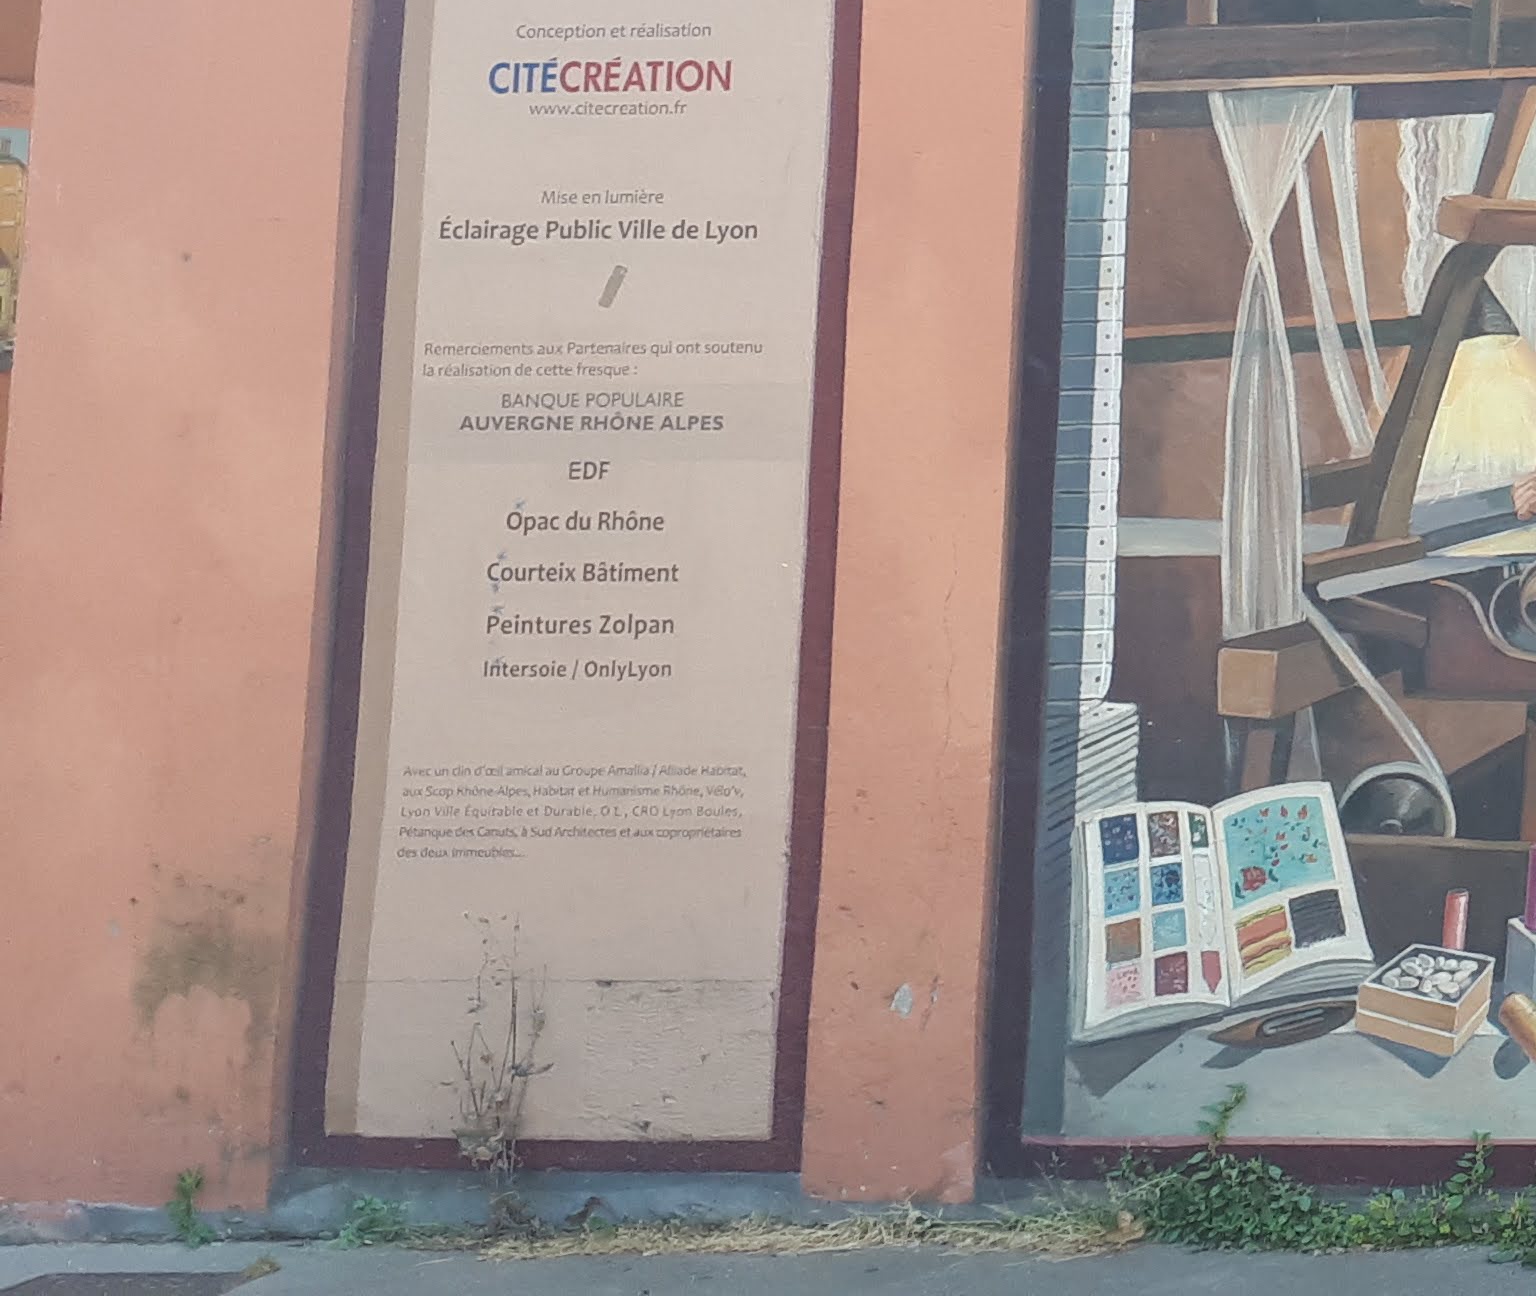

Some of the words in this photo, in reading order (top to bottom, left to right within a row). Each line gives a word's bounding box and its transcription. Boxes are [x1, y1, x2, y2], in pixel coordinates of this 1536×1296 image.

[516, 24, 605, 41] Conception
[610, 25, 625, 38] et
[630, 23, 712, 37] réalisation
[488, 57, 732, 94] CITÉCRÉATION
[529, 101, 687, 116] www.citecreation.fr
[540, 190, 578, 205] Mise
[582, 194, 601, 204] en
[605, 190, 664, 204] lumière
[439, 216, 538, 245] Éclairage
[545, 220, 612, 240] Public
[618, 220, 665, 240] Ville
[671, 220, 698, 239] de
[705, 220, 758, 244] Lyon
[424, 342, 533, 356] Remerciements
[537, 346, 563, 355] aux
[567, 341, 647, 355] Partenaires
[650, 340, 673, 358] qui
[676, 342, 700, 354] ont
[704, 341, 763, 354] soutenu
[423, 363, 435, 377] la
[438, 362, 511, 377] réalisation
[515, 363, 532, 376] de
[536, 364, 573, 376] cette
[577, 362, 629, 380] fresque
[501, 392, 580, 410] BANQUE
[585, 391, 684, 408] POPULAIRE
[460, 415, 574, 431] AUVERGNE
[581, 411, 654, 431] RHÔNE
[659, 414, 724, 430] ALPES
[568, 461, 610, 480] EDF
[506, 512, 559, 536] Opac
[566, 511, 591, 531] du
[598, 511, 664, 531] Rhône
[487, 562, 576, 582] Courteix
[583, 562, 679, 582] Bâtiment
[486, 615, 591, 635] Peintures
[600, 614, 674, 639] Zolpan
[483, 660, 566, 678] Intersoie
[584, 660, 672, 681] OnlyLyon
